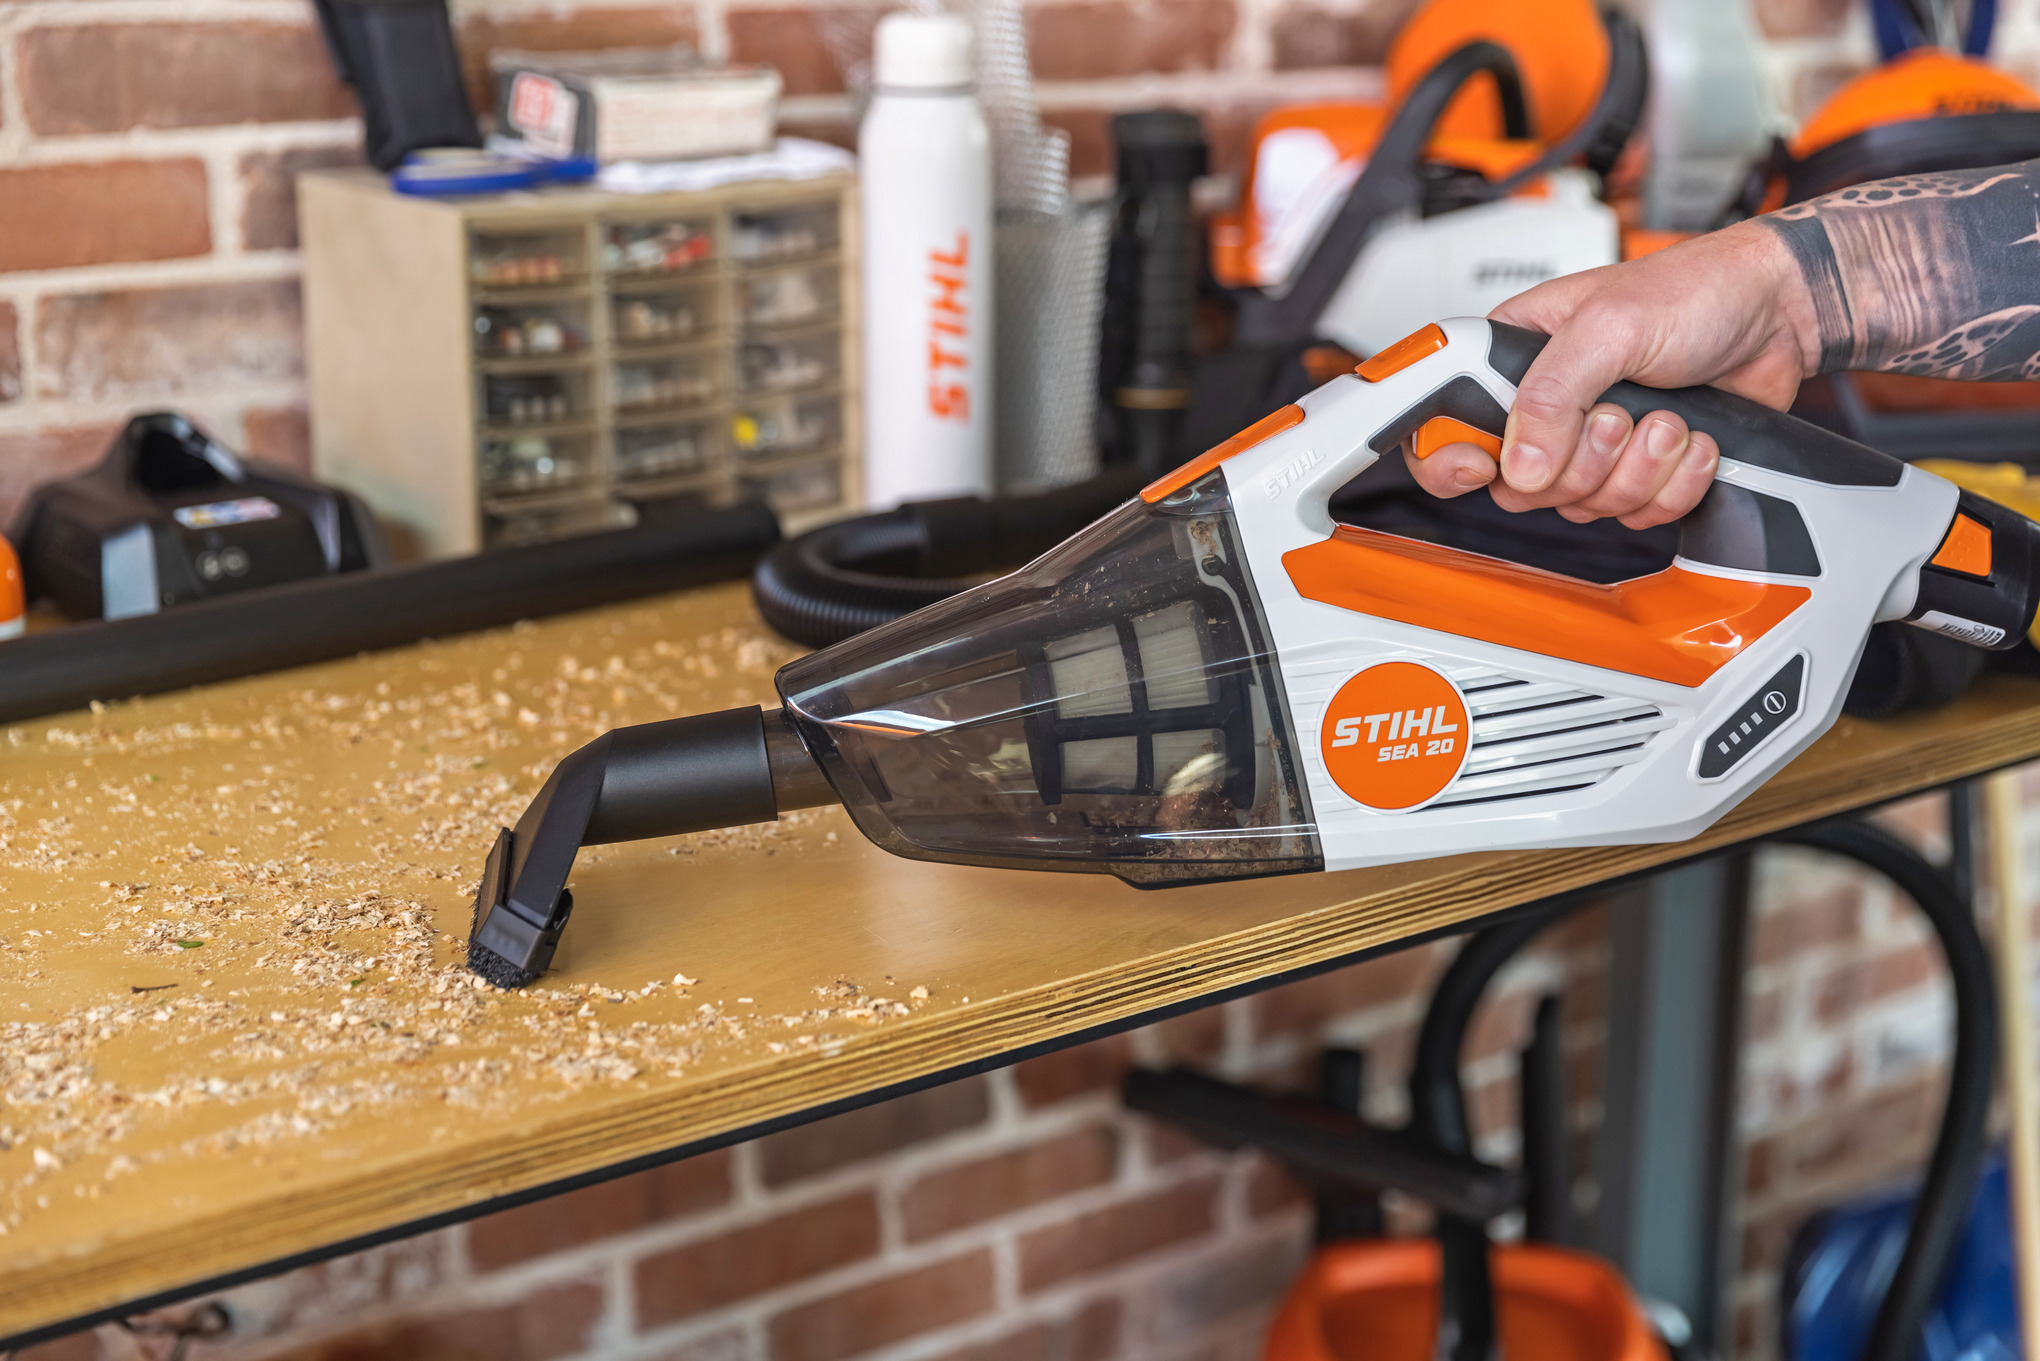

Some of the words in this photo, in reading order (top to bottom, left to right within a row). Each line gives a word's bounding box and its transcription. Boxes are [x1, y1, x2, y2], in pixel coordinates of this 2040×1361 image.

[929, 230, 969, 424] STIHL
[1264, 448, 1326, 500] STIHL
[1332, 705, 1458, 748] STIHL
[1377, 743, 1419, 763] SEA
[1425, 738, 1455, 756] 20
